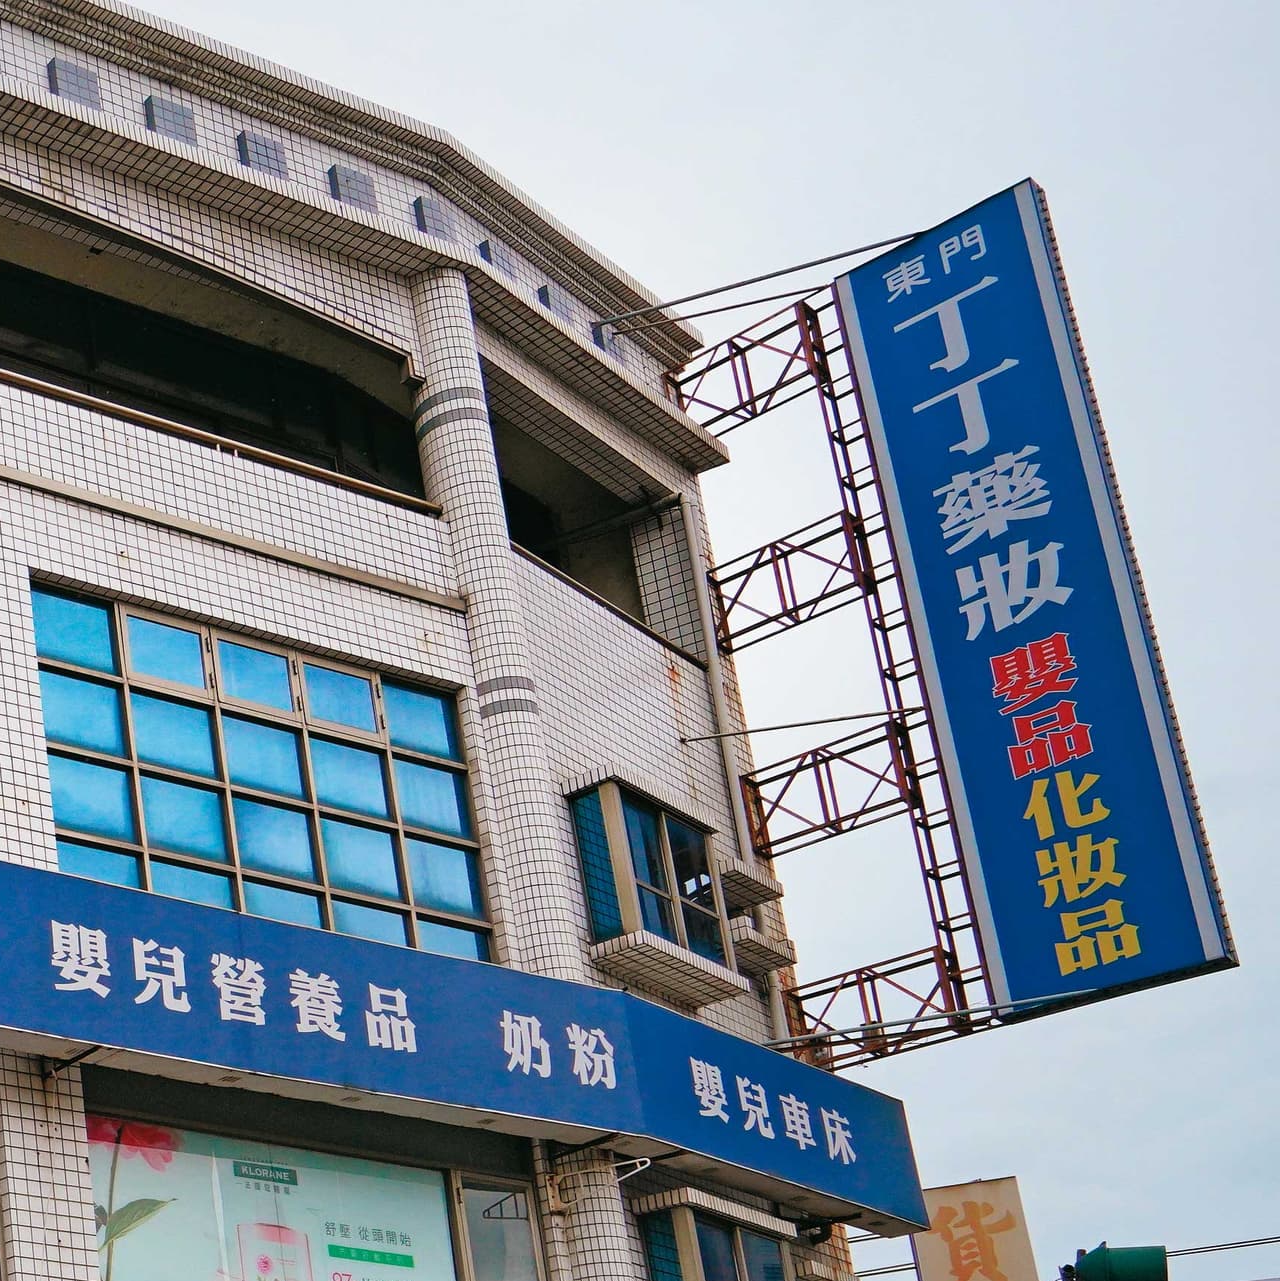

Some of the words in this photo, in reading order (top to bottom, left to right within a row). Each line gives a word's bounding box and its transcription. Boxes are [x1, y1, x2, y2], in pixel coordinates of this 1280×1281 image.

[882, 223, 987, 303] 東門
[892, 276, 1074, 641] 丁丁藥妝
[990, 632, 1093, 781] 嬰品
[1022, 773, 1143, 977] 化妝品
[50, 917, 418, 1054] 嬰兒營養品
[498, 1007, 618, 1091] 奶粉
[688, 1055, 857, 1166] 嬰兒車床
[240, 1166, 289, 1181] KLORANE
